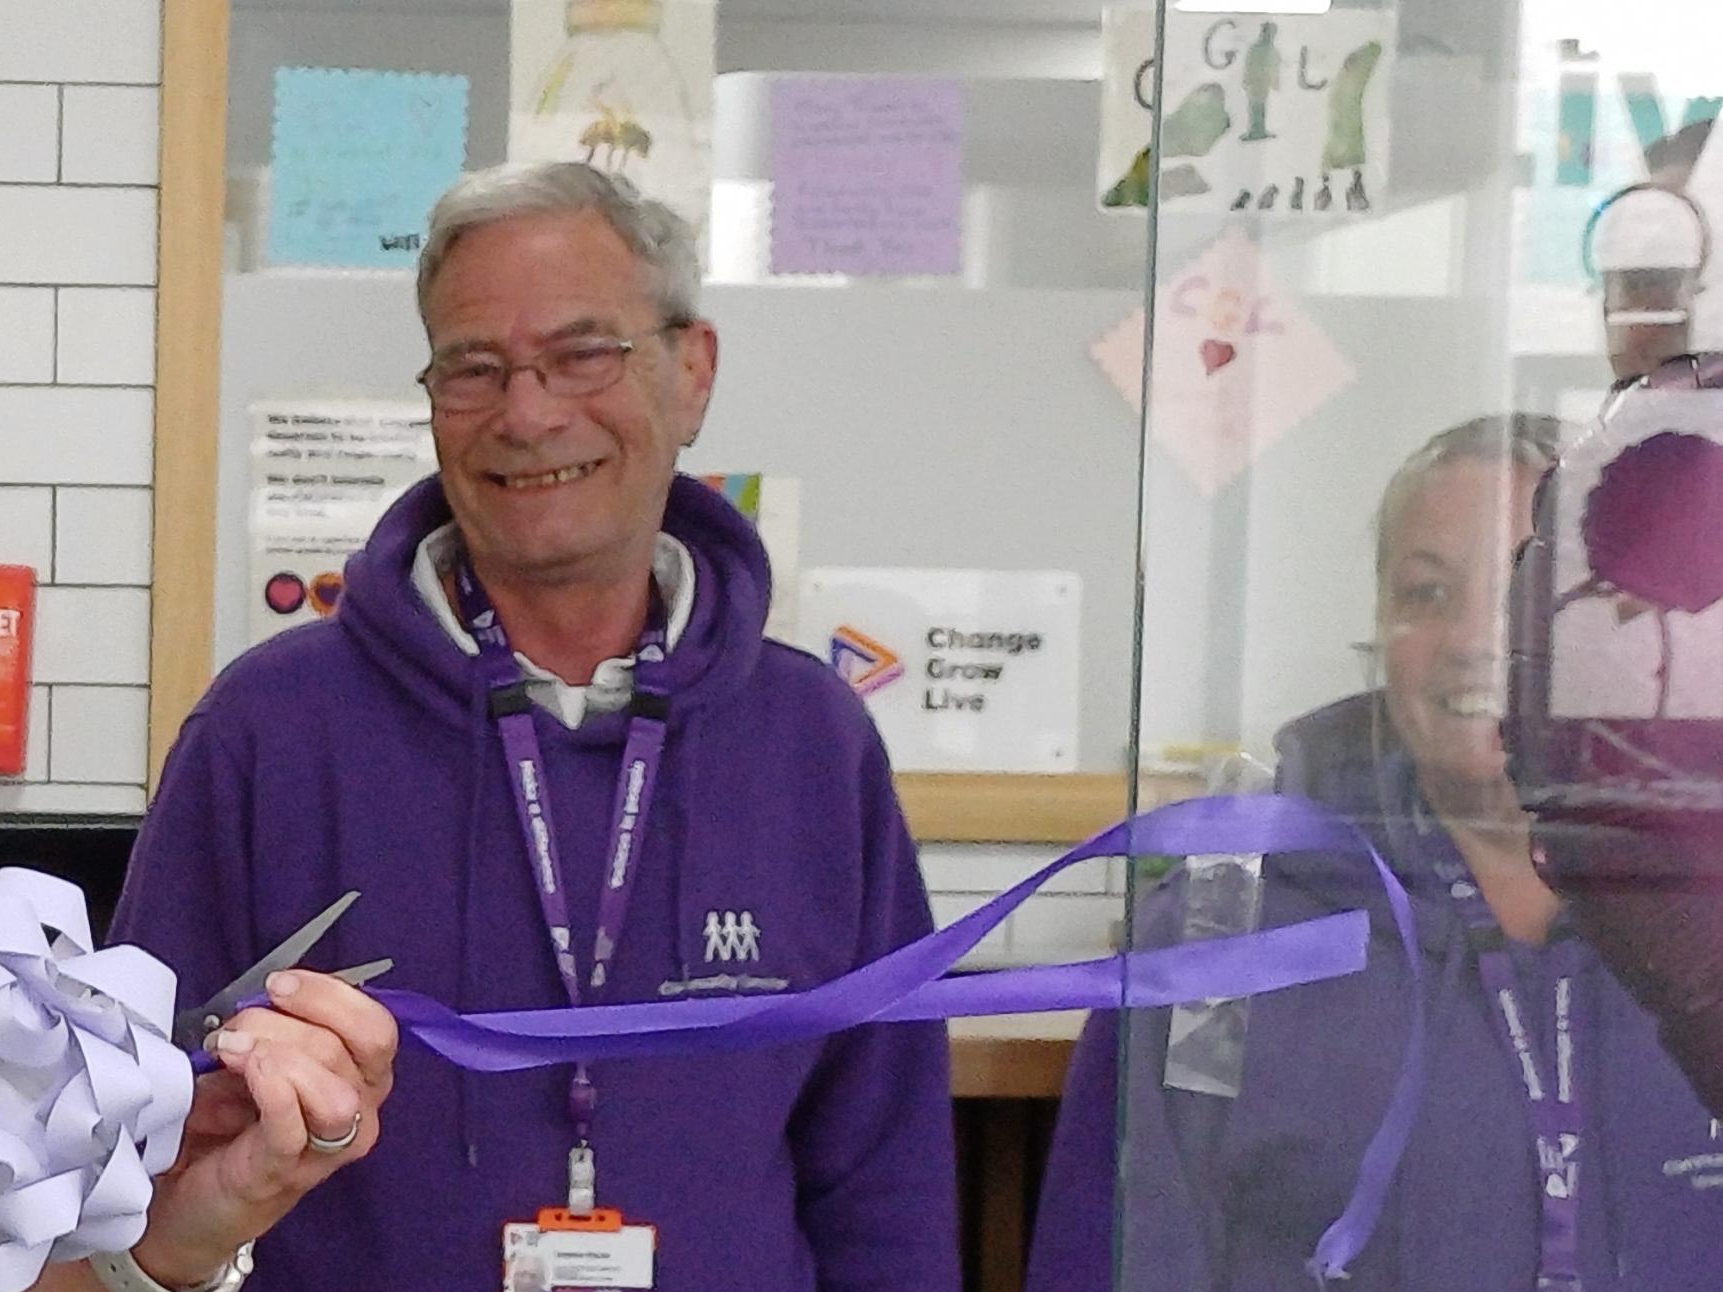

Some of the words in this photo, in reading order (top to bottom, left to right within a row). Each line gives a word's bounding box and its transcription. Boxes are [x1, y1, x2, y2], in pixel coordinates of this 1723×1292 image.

[926, 627, 1043, 656] Change
[926, 658, 1003, 680] Grow
[923, 688, 985, 712] Live
